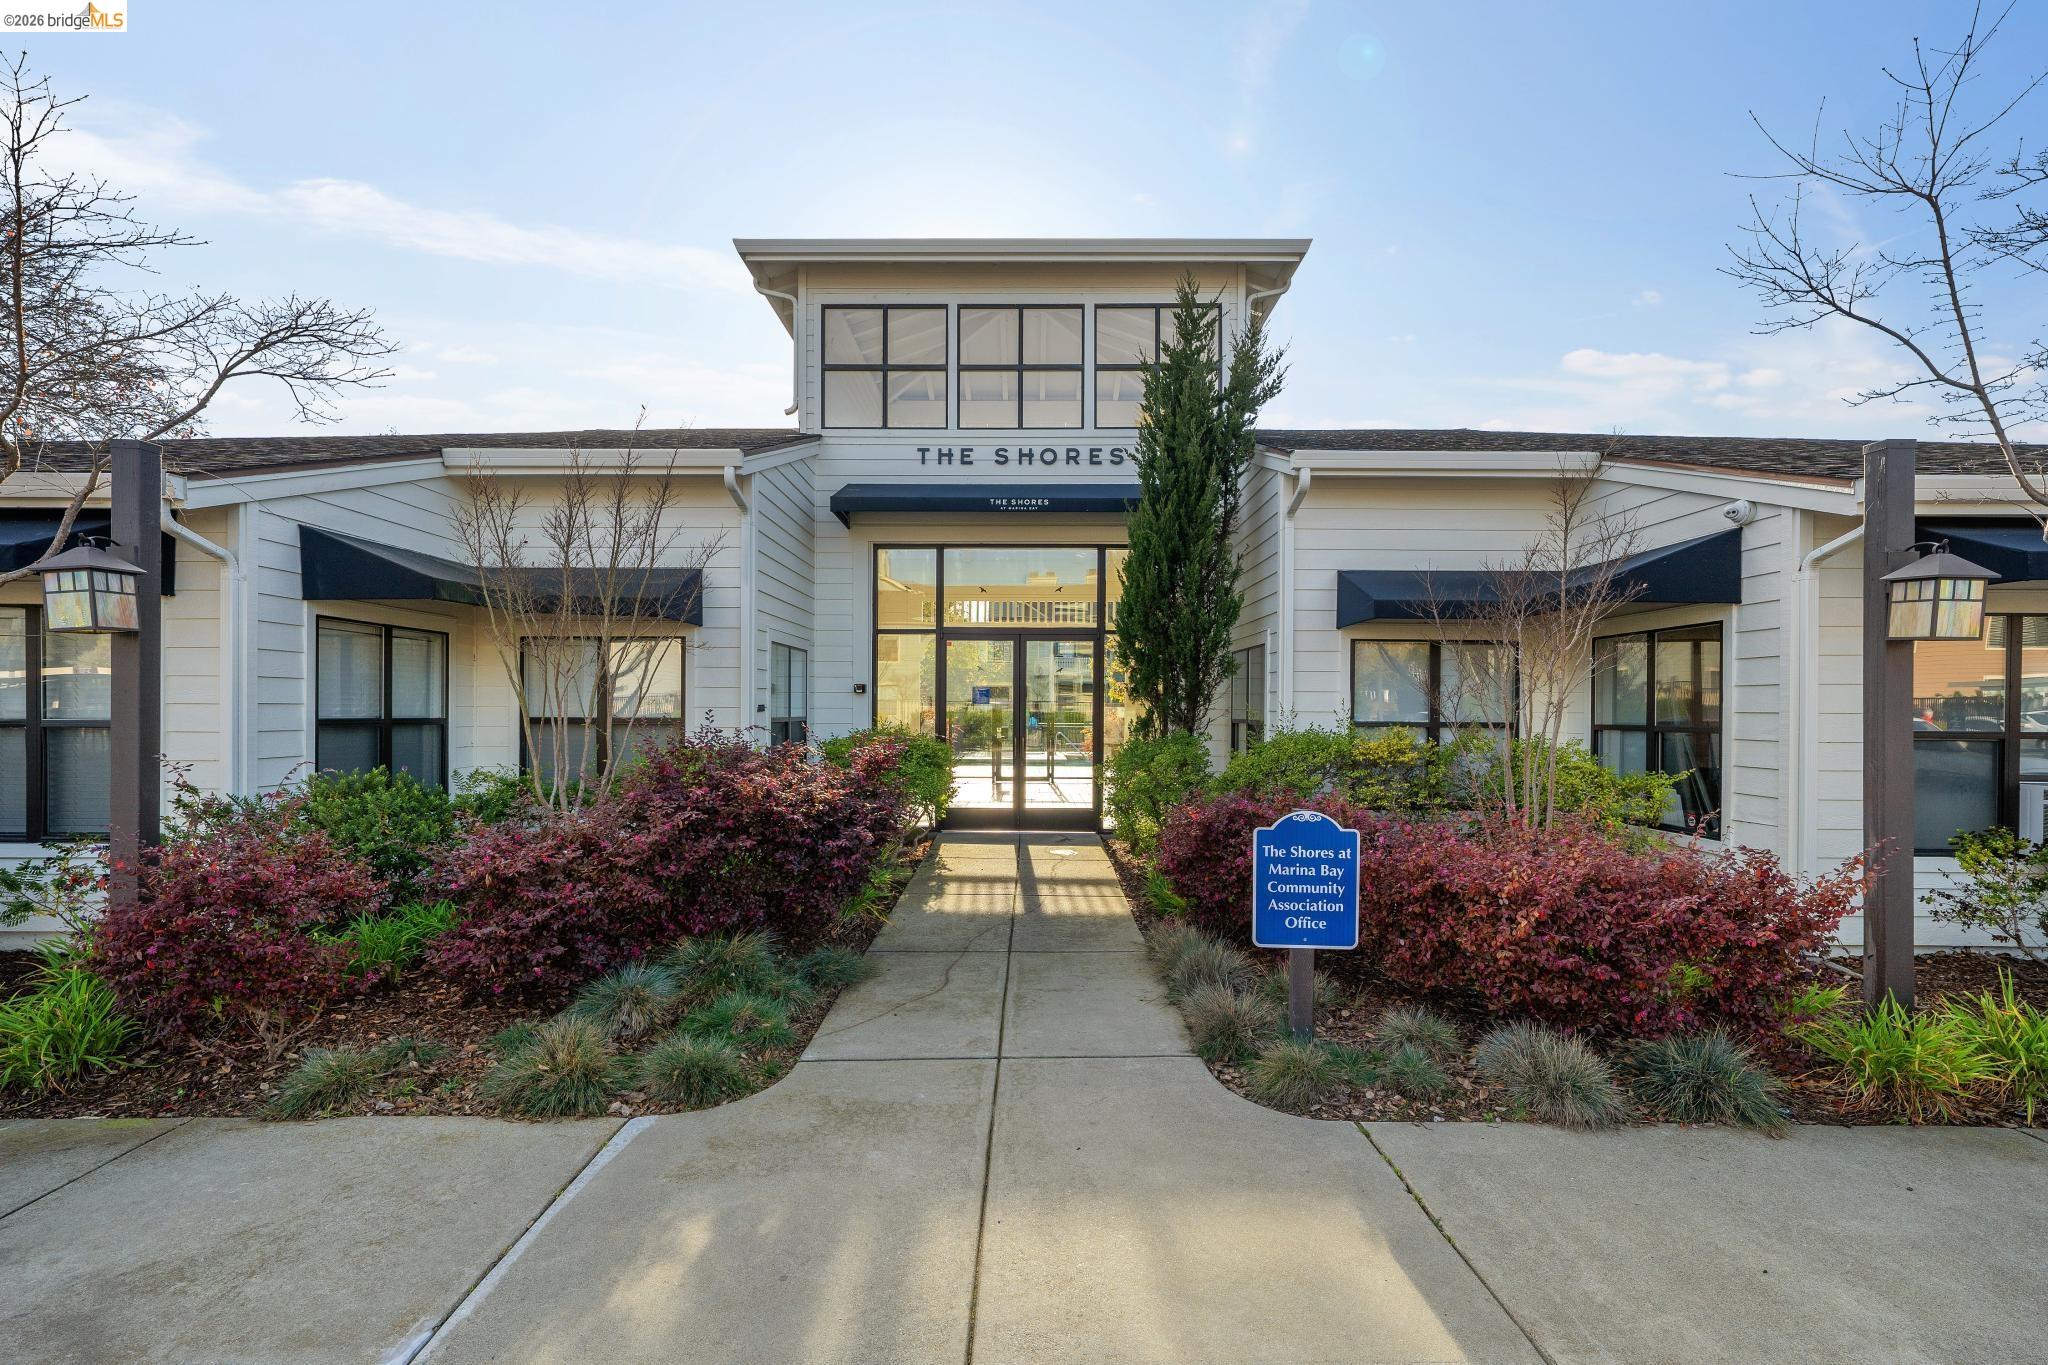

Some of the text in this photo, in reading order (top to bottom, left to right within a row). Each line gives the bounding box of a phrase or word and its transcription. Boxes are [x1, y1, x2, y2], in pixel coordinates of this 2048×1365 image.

[917, 447, 1125, 465] THE SHORES
[1262, 845, 1351, 859] The Shores at
[1268, 863, 1344, 880] Marina Bay
[1267, 881, 1345, 898] Community
[1268, 899, 1344, 912] Association
[1285, 916, 1327, 929] Office
